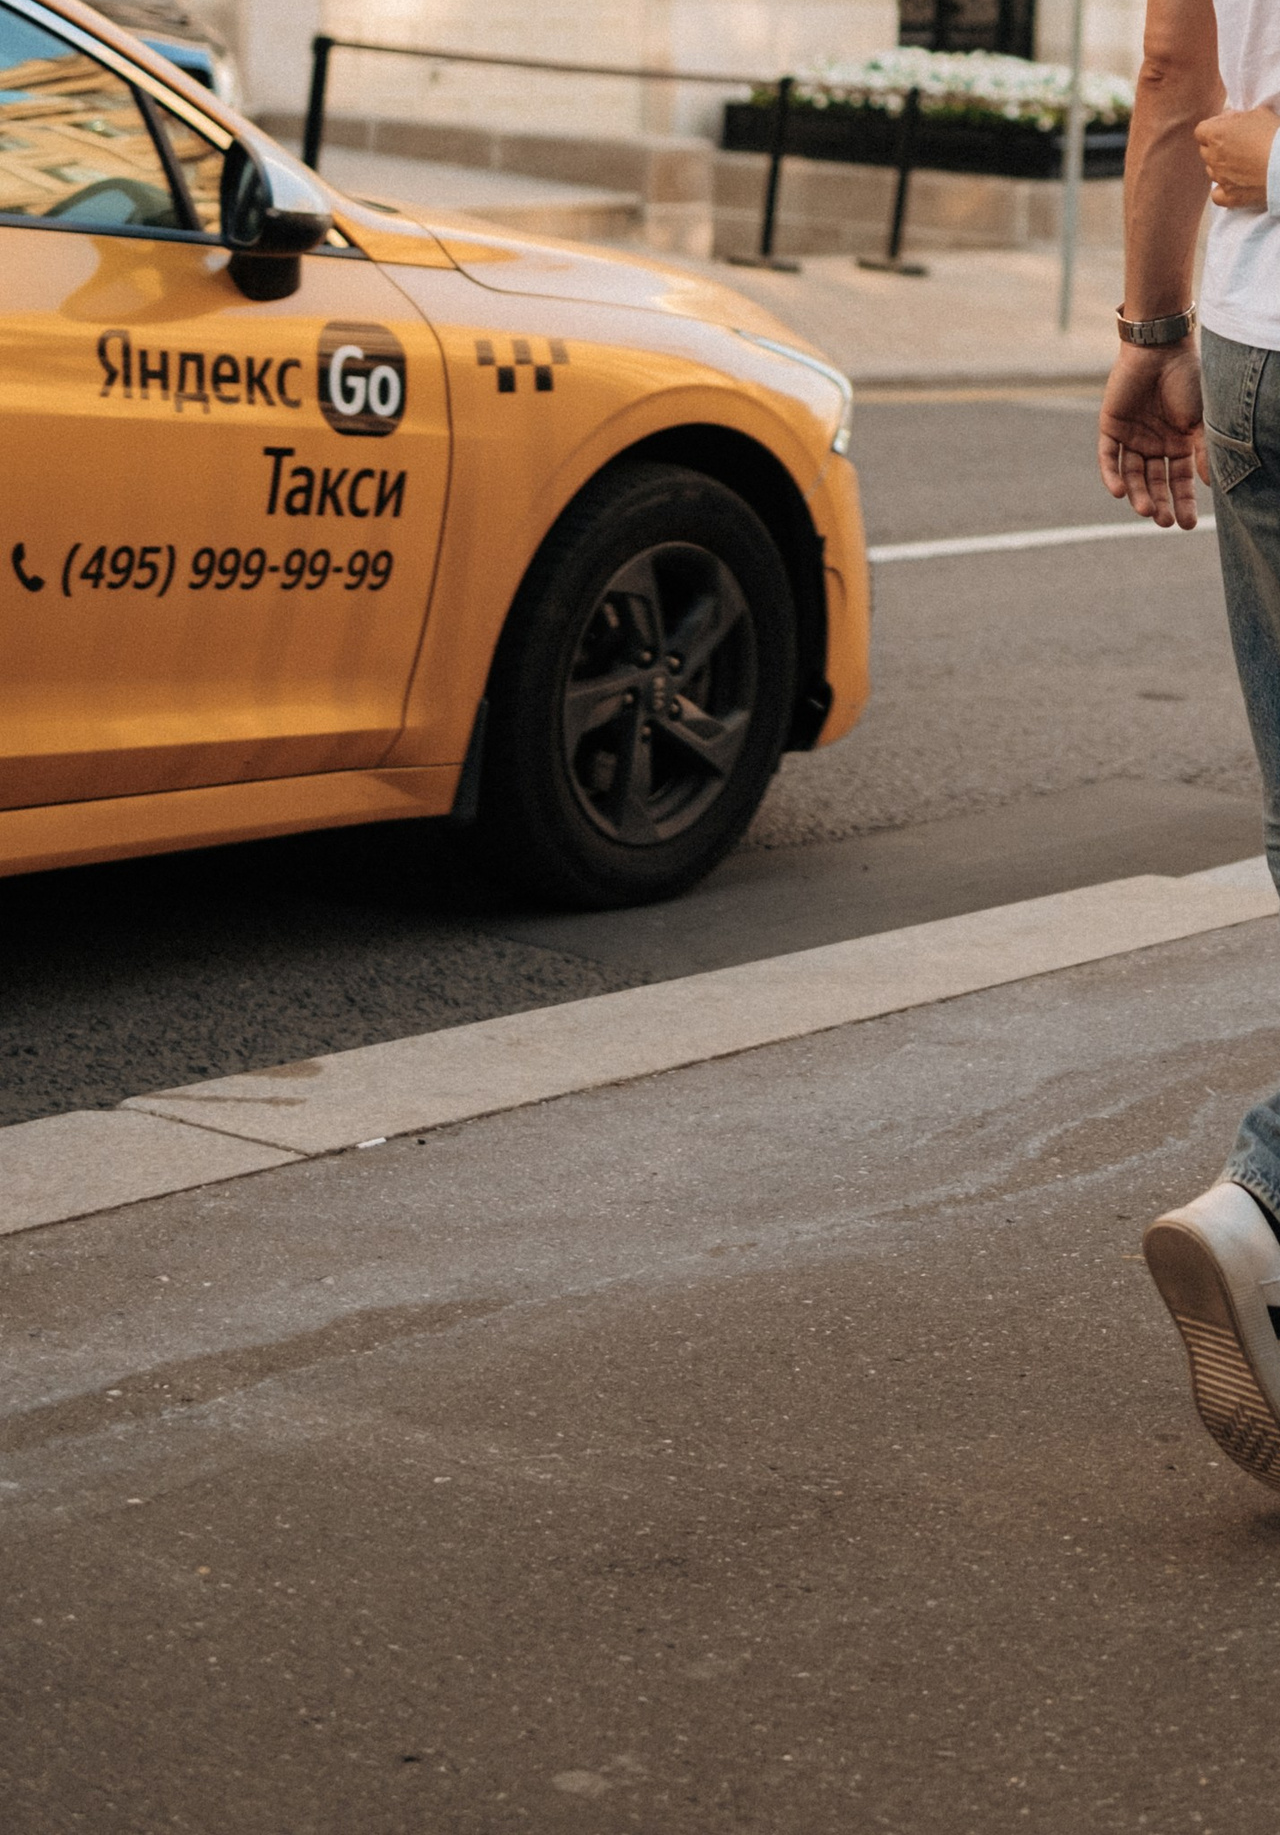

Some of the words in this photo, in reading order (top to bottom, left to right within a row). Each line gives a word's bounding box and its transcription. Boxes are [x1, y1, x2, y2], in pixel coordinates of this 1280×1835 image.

[97, 329, 302, 413] Яндекс
[328, 345, 402, 416] Go
[263, 447, 407, 518] Такси
[61, 543, 176, 597] (495)
[188, 547, 394, 591] 999-99-99
